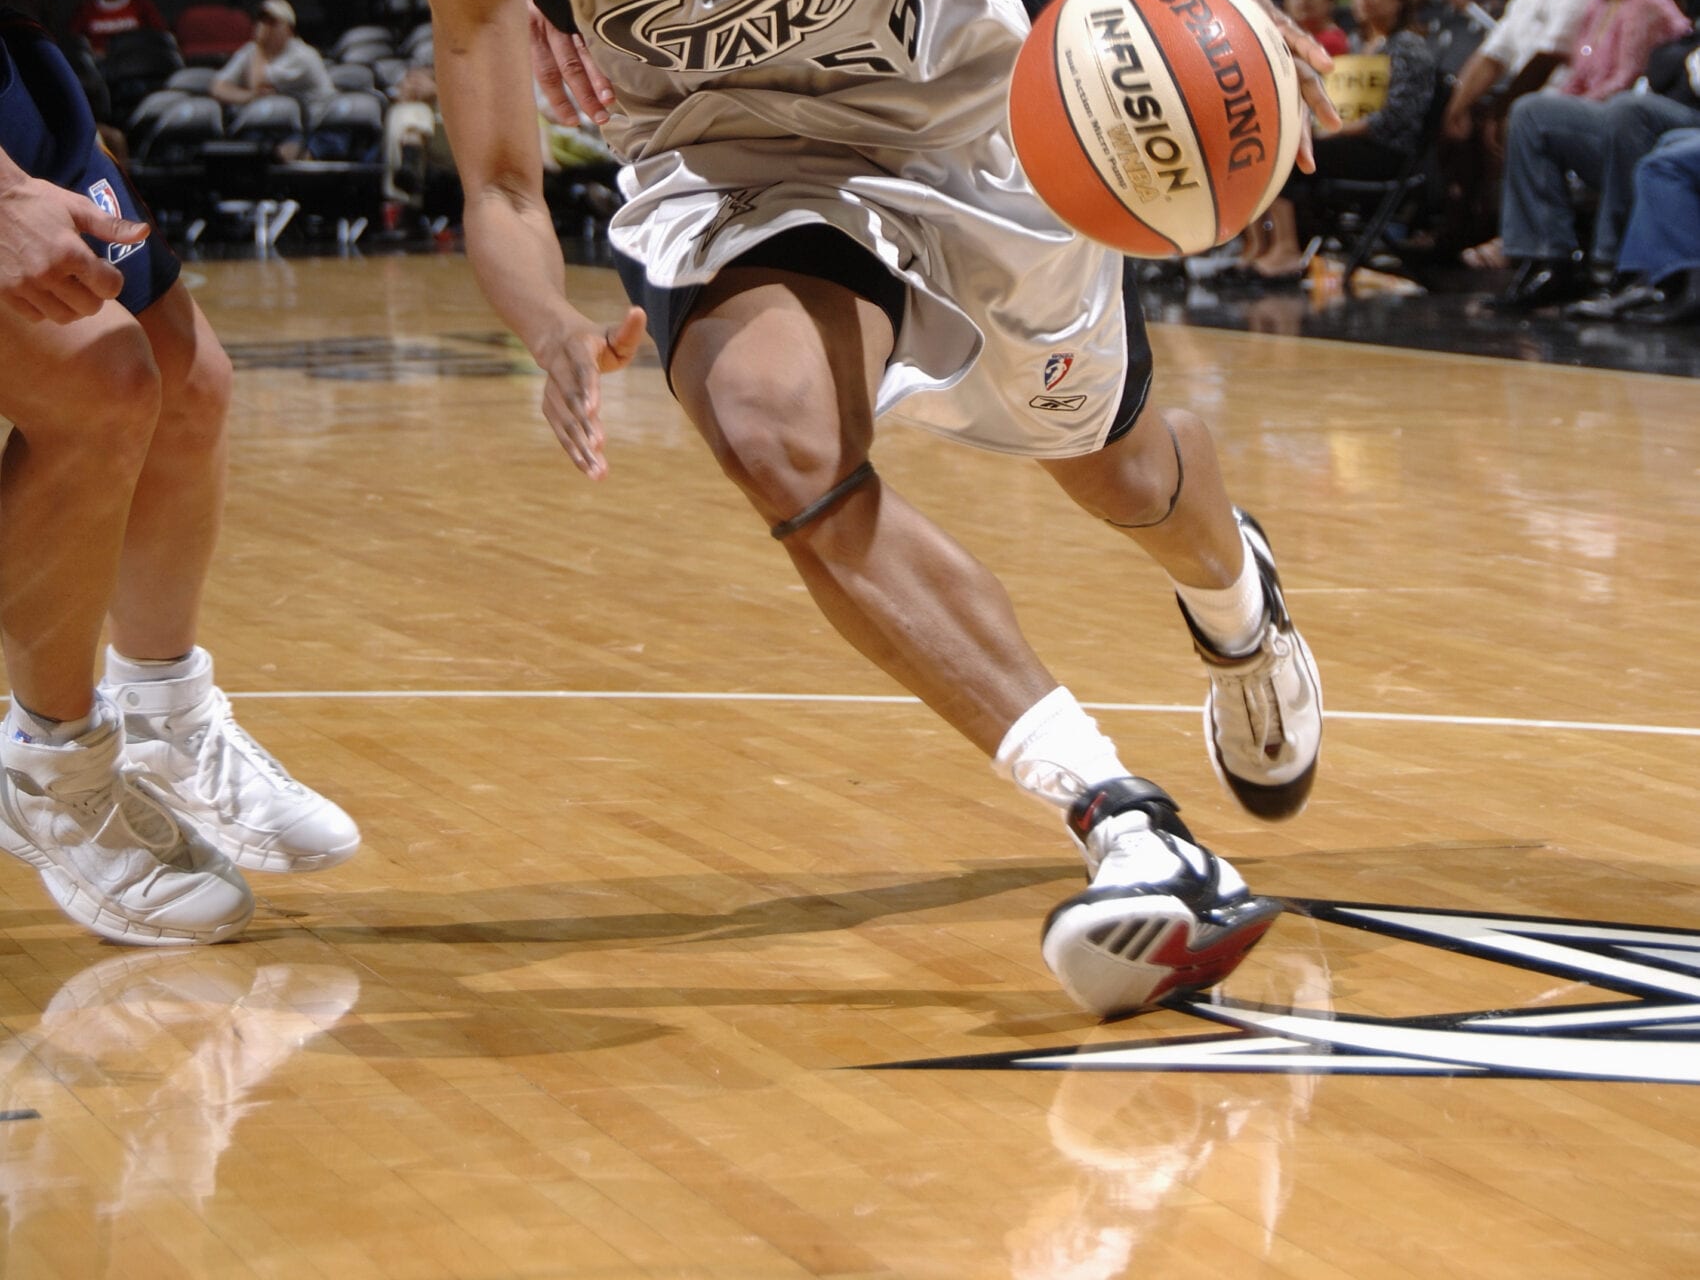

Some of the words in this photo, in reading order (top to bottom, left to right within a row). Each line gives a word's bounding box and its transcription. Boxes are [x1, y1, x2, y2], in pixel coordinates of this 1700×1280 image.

[1074, 78, 1094, 119] Action
[1092, 120, 1110, 155] Micro
[1109, 156, 1128, 191] Pump
[1090, 7, 1200, 195] INFUSION
[1106, 122, 1160, 204] WNBA
